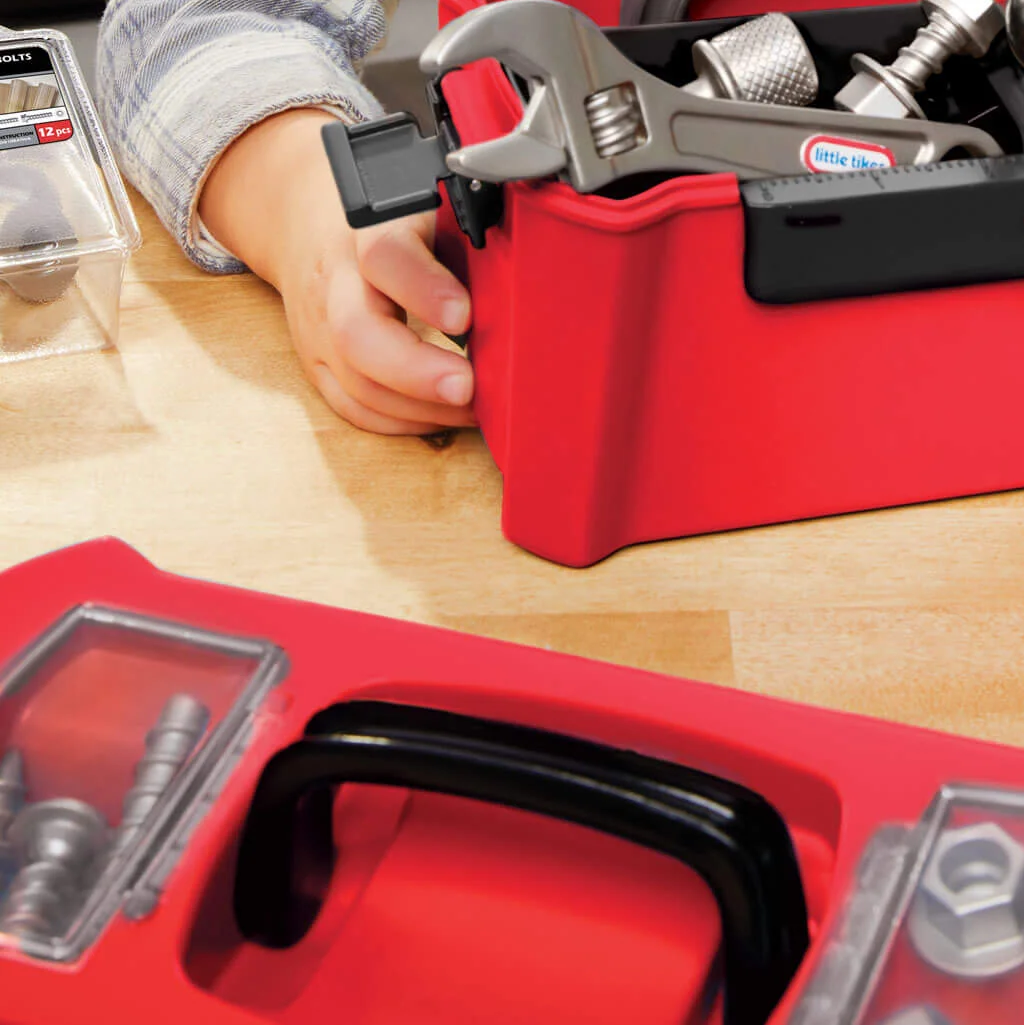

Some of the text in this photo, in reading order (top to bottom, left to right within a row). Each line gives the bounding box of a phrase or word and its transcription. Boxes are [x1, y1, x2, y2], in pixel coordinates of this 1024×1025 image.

[0, 52, 32, 63] OLTS
[38, 127, 71, 137] 12 pcs
[815, 147, 849, 166] little
